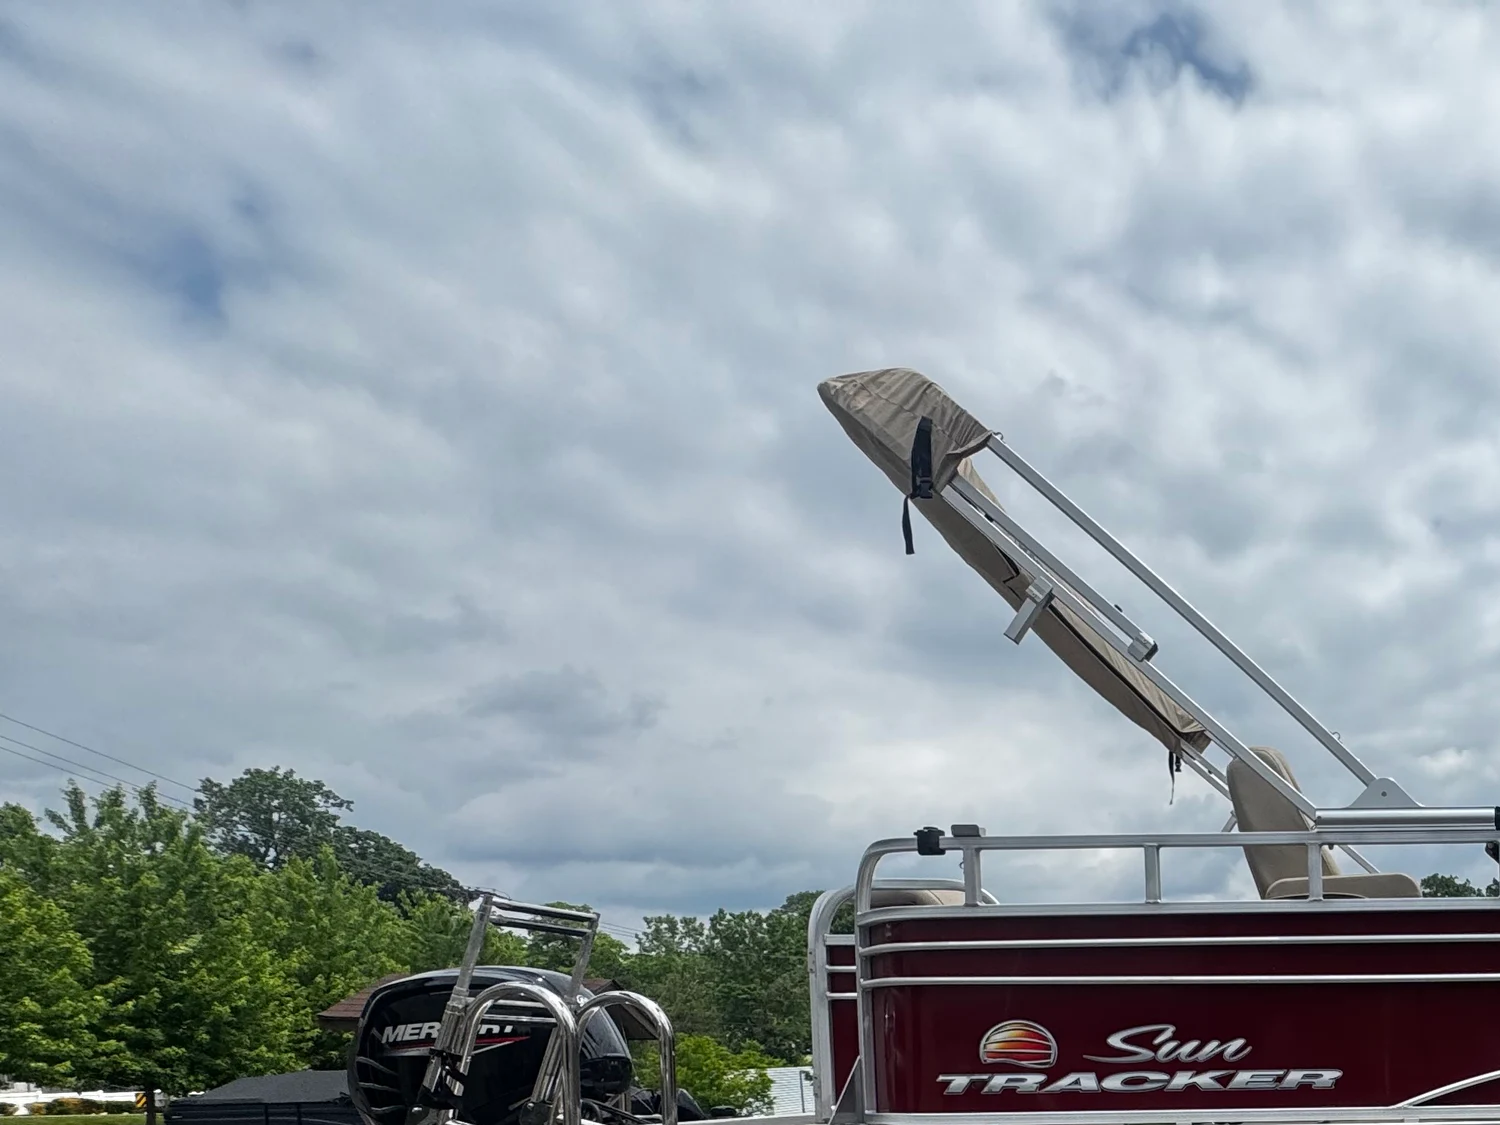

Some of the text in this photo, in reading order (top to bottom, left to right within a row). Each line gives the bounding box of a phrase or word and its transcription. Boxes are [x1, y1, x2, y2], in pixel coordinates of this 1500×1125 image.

[381, 1020, 515, 1044] MERR
[1082, 1023, 1253, 1064] Sun
[936, 1067, 1344, 1096] TRACKER
